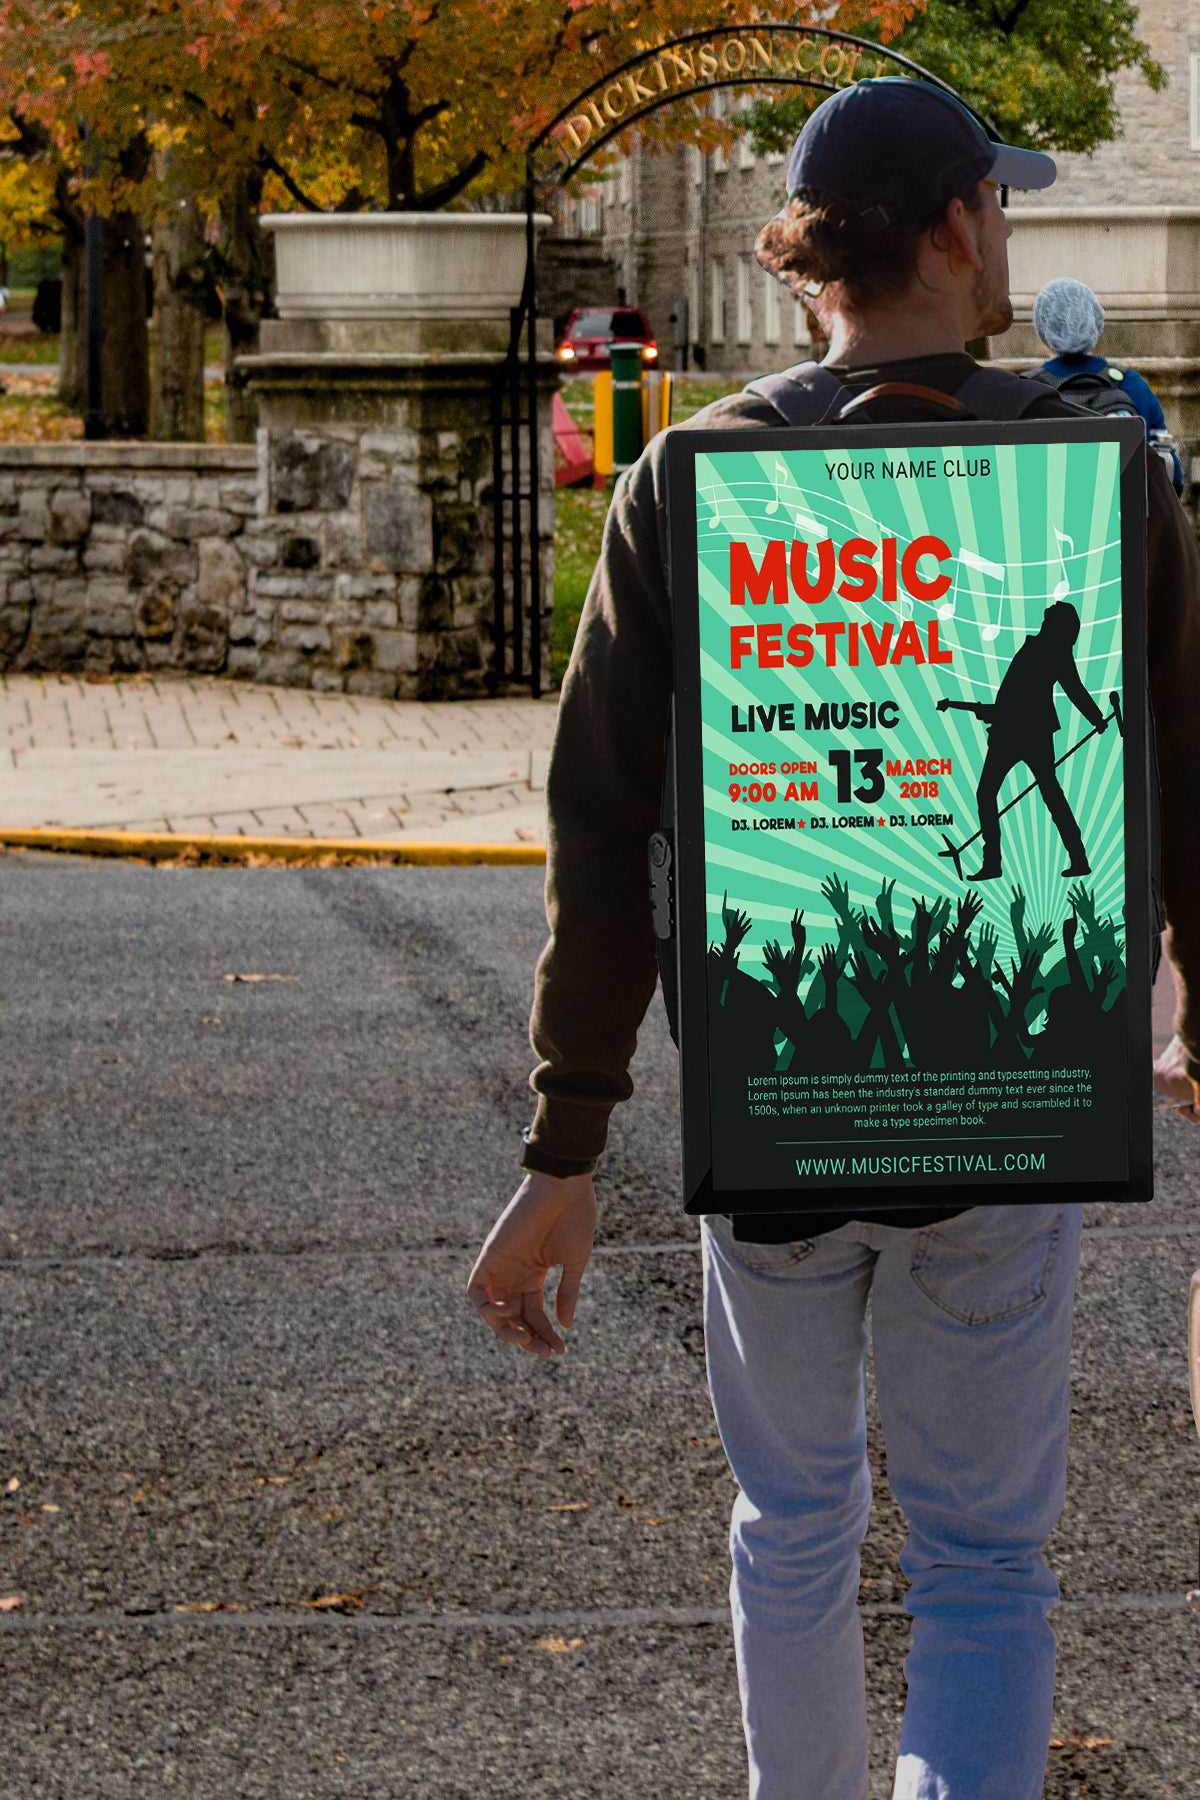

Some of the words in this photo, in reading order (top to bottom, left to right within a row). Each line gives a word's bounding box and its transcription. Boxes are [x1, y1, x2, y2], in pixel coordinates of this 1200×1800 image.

[565, 37, 773, 150] DICKINSON
[824, 461, 875, 482] YOUR
[881, 460, 937, 480] NAME
[943, 458, 992, 478] CLUB
[729, 535, 953, 606] MUSIC
[729, 619, 953, 670] FESTIVAL
[730, 702, 796, 733] LIVE
[804, 700, 900, 731] MUSIC
[729, 762, 777, 776] DOORS
[780, 761, 817, 775] OPEN
[828, 748, 885, 804] 13
[886, 758, 952, 777] MARCH
[728, 782, 777, 804] 9:00
[783, 781, 819, 802] AM
[899, 781, 939, 799] 2018
[753, 817, 796, 830] LOREM
[832, 815, 875, 828] LOREM
[911, 813, 954, 826] LOREM
[747, 1075, 778, 1086] Lorem
[779, 1074, 809, 1087] Ipsum
[810, 1074, 819, 1084] is
[821, 1073, 852, 1086] simply
[854, 1073, 889, 1085] dummy
[891, 1073, 909, 1083] text
[911, 1072, 921, 1082] of
[923, 1072, 938, 1082] the
[940, 1071, 976, 1083] printing
[978, 1070, 996, 1081] and
[998, 1069, 1050, 1082] typesetting
[1051, 1068, 1092, 1080] industry.
[748, 1090, 778, 1101] Lorem
[780, 1090, 810, 1102] Ipsum
[812, 1089, 830, 1099] has
[832, 1088, 855, 1099] been
[858, 1088, 874, 1098] the
[923, 1085, 965, 1097] standard
[968, 1085, 1003, 1097] dummy
[1005, 1084, 1023, 1094] text
[1026, 1085, 1046, 1094] ever
[1049, 1083, 1074, 1093] since
[1077, 1082, 1092, 1093] the
[749, 1105, 780, 1116] 1500s,
[782, 1104, 807, 1114] when
[810, 1106, 822, 1114] an
[825, 1103, 867, 1114] unknown
[869, 1102, 900, 1115] printer
[902, 1101, 923, 1112] took
[926, 1103, 932, 1111] a
[935, 1100, 963, 1113] galley
[965, 1099, 976, 1110] of
[978, 1100, 998, 1112] type
[1001, 1099, 1018, 1109] and
[1021, 1097, 1071, 1109] scrambled
[1073, 1098, 1080, 1108] it
[1082, 1098, 1092, 1107] to
[854, 1117, 880, 1128] make
[882, 1119, 888, 1127] a
[890, 1117, 910, 1129] type
[913, 1116, 958, 1128] specimen
[960, 1114, 986, 1125] book.
[795, 1153, 1047, 1176] WWW.MUSICFESTIVAL.COM
